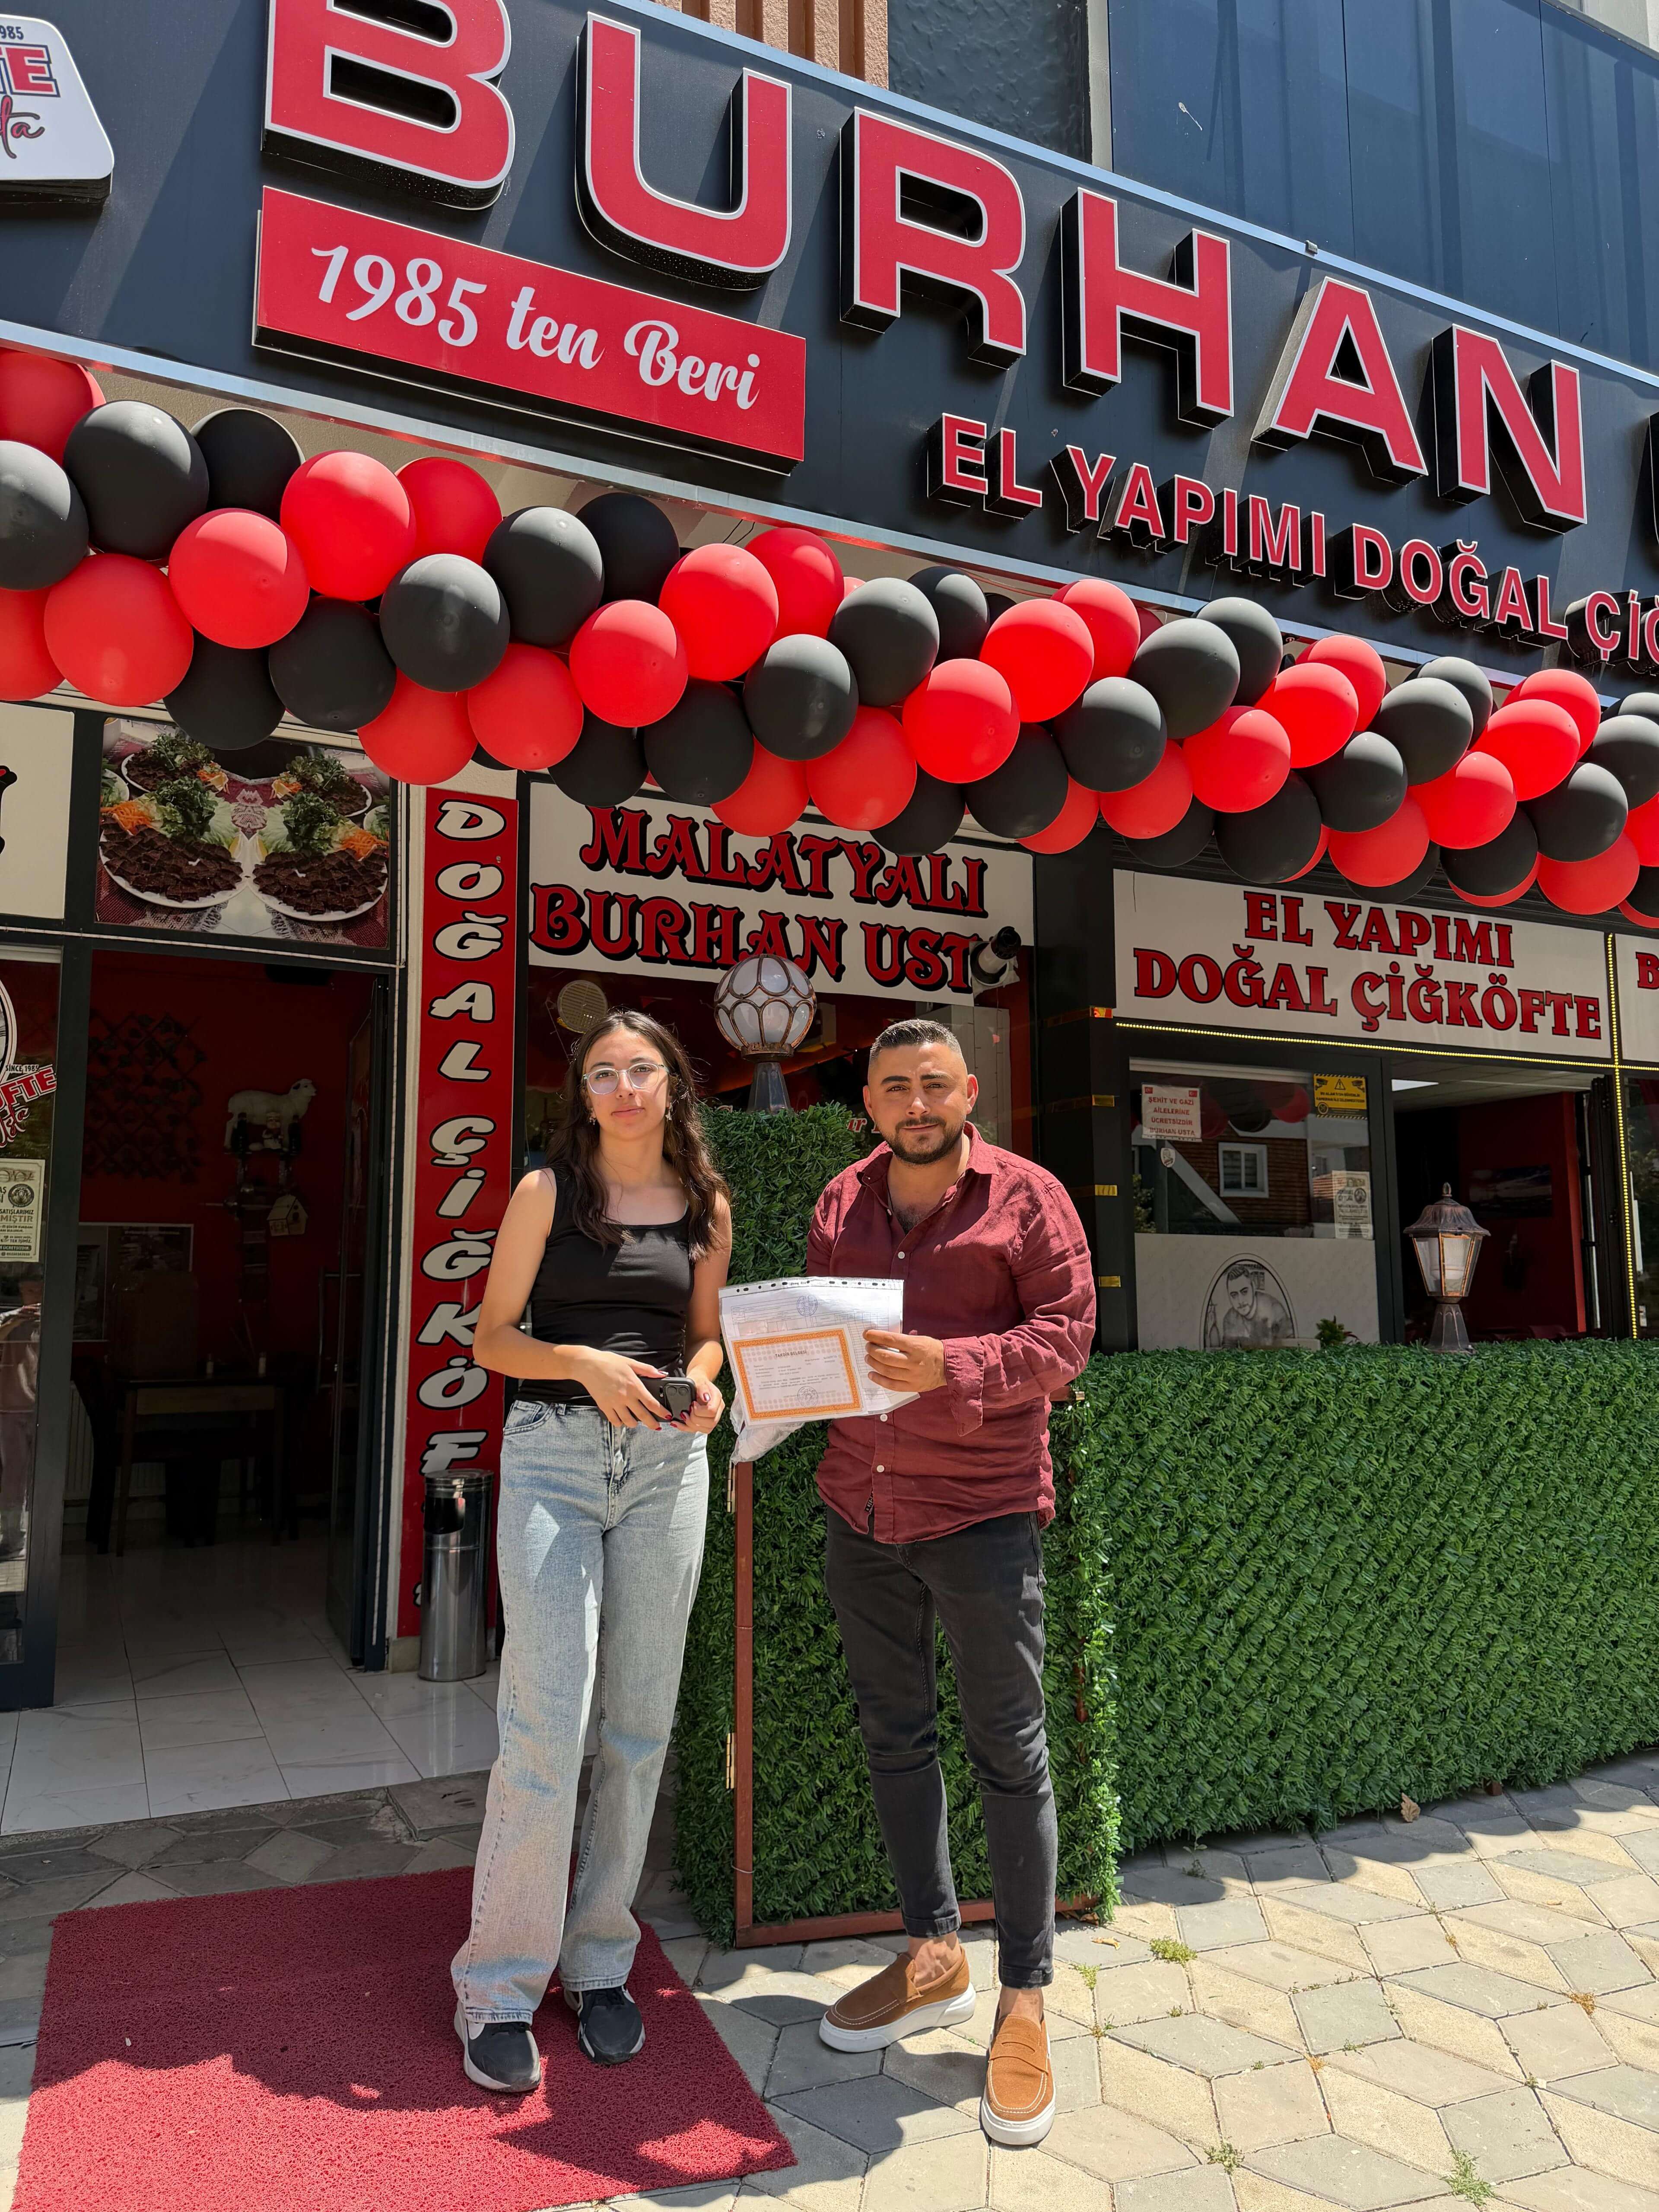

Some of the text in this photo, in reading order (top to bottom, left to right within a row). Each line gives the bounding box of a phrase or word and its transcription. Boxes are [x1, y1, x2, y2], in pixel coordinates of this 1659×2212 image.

[264, 0, 1587, 524] BURHAN
[311, 245, 760, 410] 1985 ten Beri
[942, 412, 1042, 508] EL
[1065, 444, 1326, 578] YAPIMI
[1352, 523, 1568, 641] DOĞAL
[580, 804, 988, 918] MALATYALI
[530, 883, 983, 995] BURHAN UST
[1243, 890, 1515, 968] EL YAPIMI
[1133, 943, 1602, 1041] DOĞAL ÇİĞKÖFTE
[0, 1066, 57, 1111] FTE
[1151, 1116, 1193, 1125] ÜCRETSİZDİR
[1154, 1106, 1190, 1116] AİLELERİNE
[414, 798, 509, 1608] DOĞAL ÇİĞKÖF
